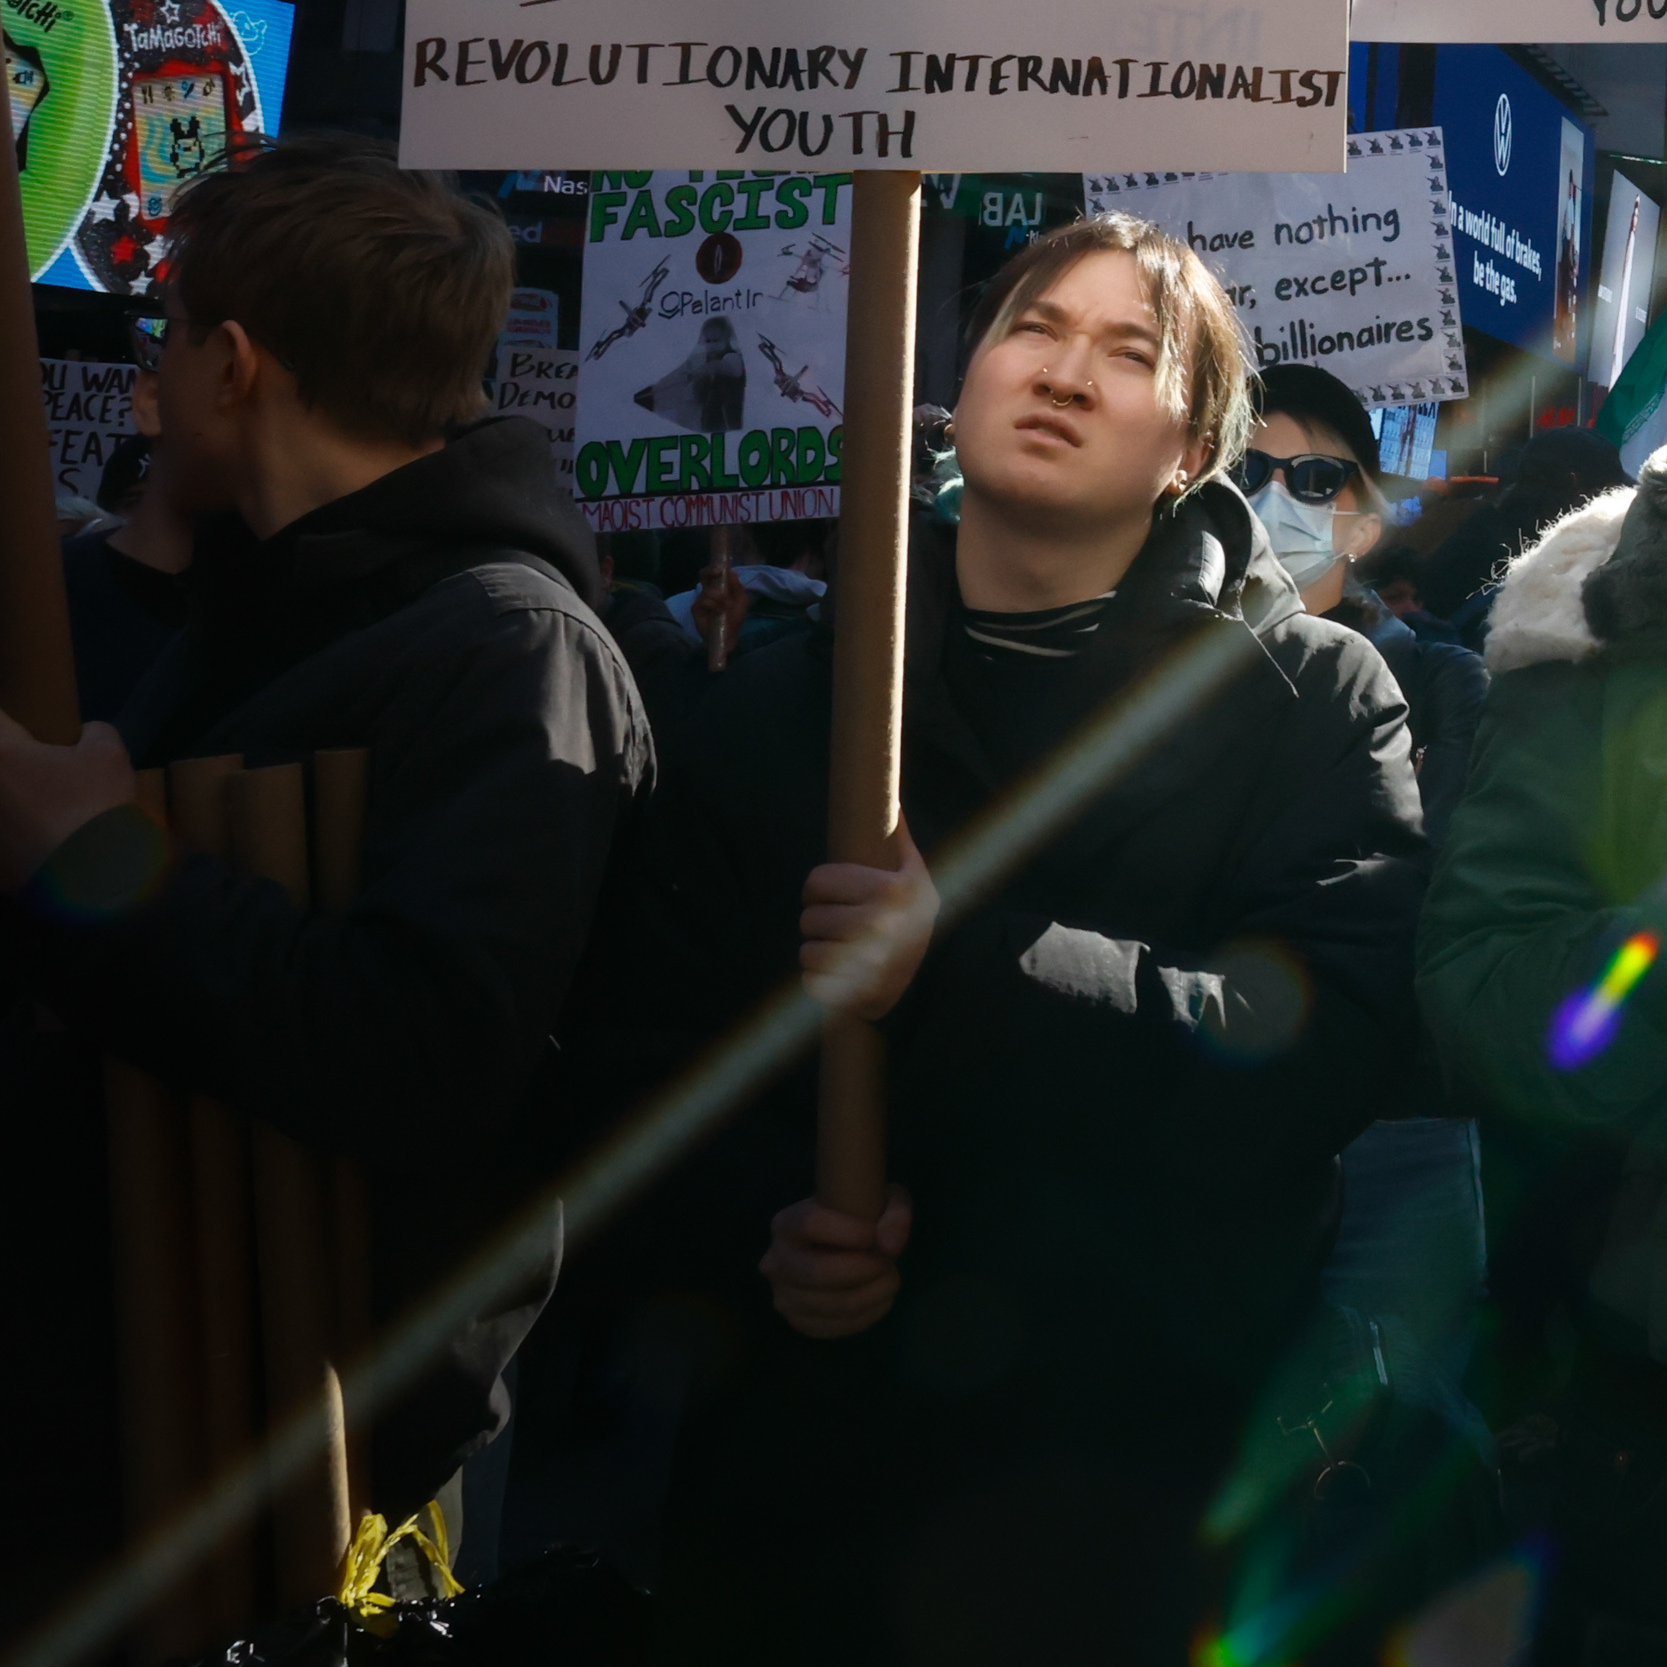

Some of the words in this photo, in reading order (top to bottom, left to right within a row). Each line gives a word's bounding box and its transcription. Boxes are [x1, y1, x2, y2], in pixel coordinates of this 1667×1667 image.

[413, 36, 867, 95] REVOLUTIONARY
[887, 49, 1347, 109] INTERNATIONALIST
[725, 104, 916, 159] YOUTH
[589, 172, 853, 242] FASCIST
[1187, 221, 1255, 252] have
[1274, 203, 1400, 243] nothing
[1465, 210, 1490, 247] world
[1491, 215, 1506, 256] full
[1515, 231, 1542, 282] brakes,
[1274, 257, 1412, 302] except...
[1473, 250, 1485, 287] be
[1485, 259, 1500, 295] the
[1499, 276, 1518, 307] gas.
[1254, 315, 1434, 367] billionaires
[576, 425, 844, 499] OVERLORDS
[582, 497, 656, 532] MAOIST
[659, 491, 766, 528] COMMUNIST
[768, 487, 835, 522] UNION
